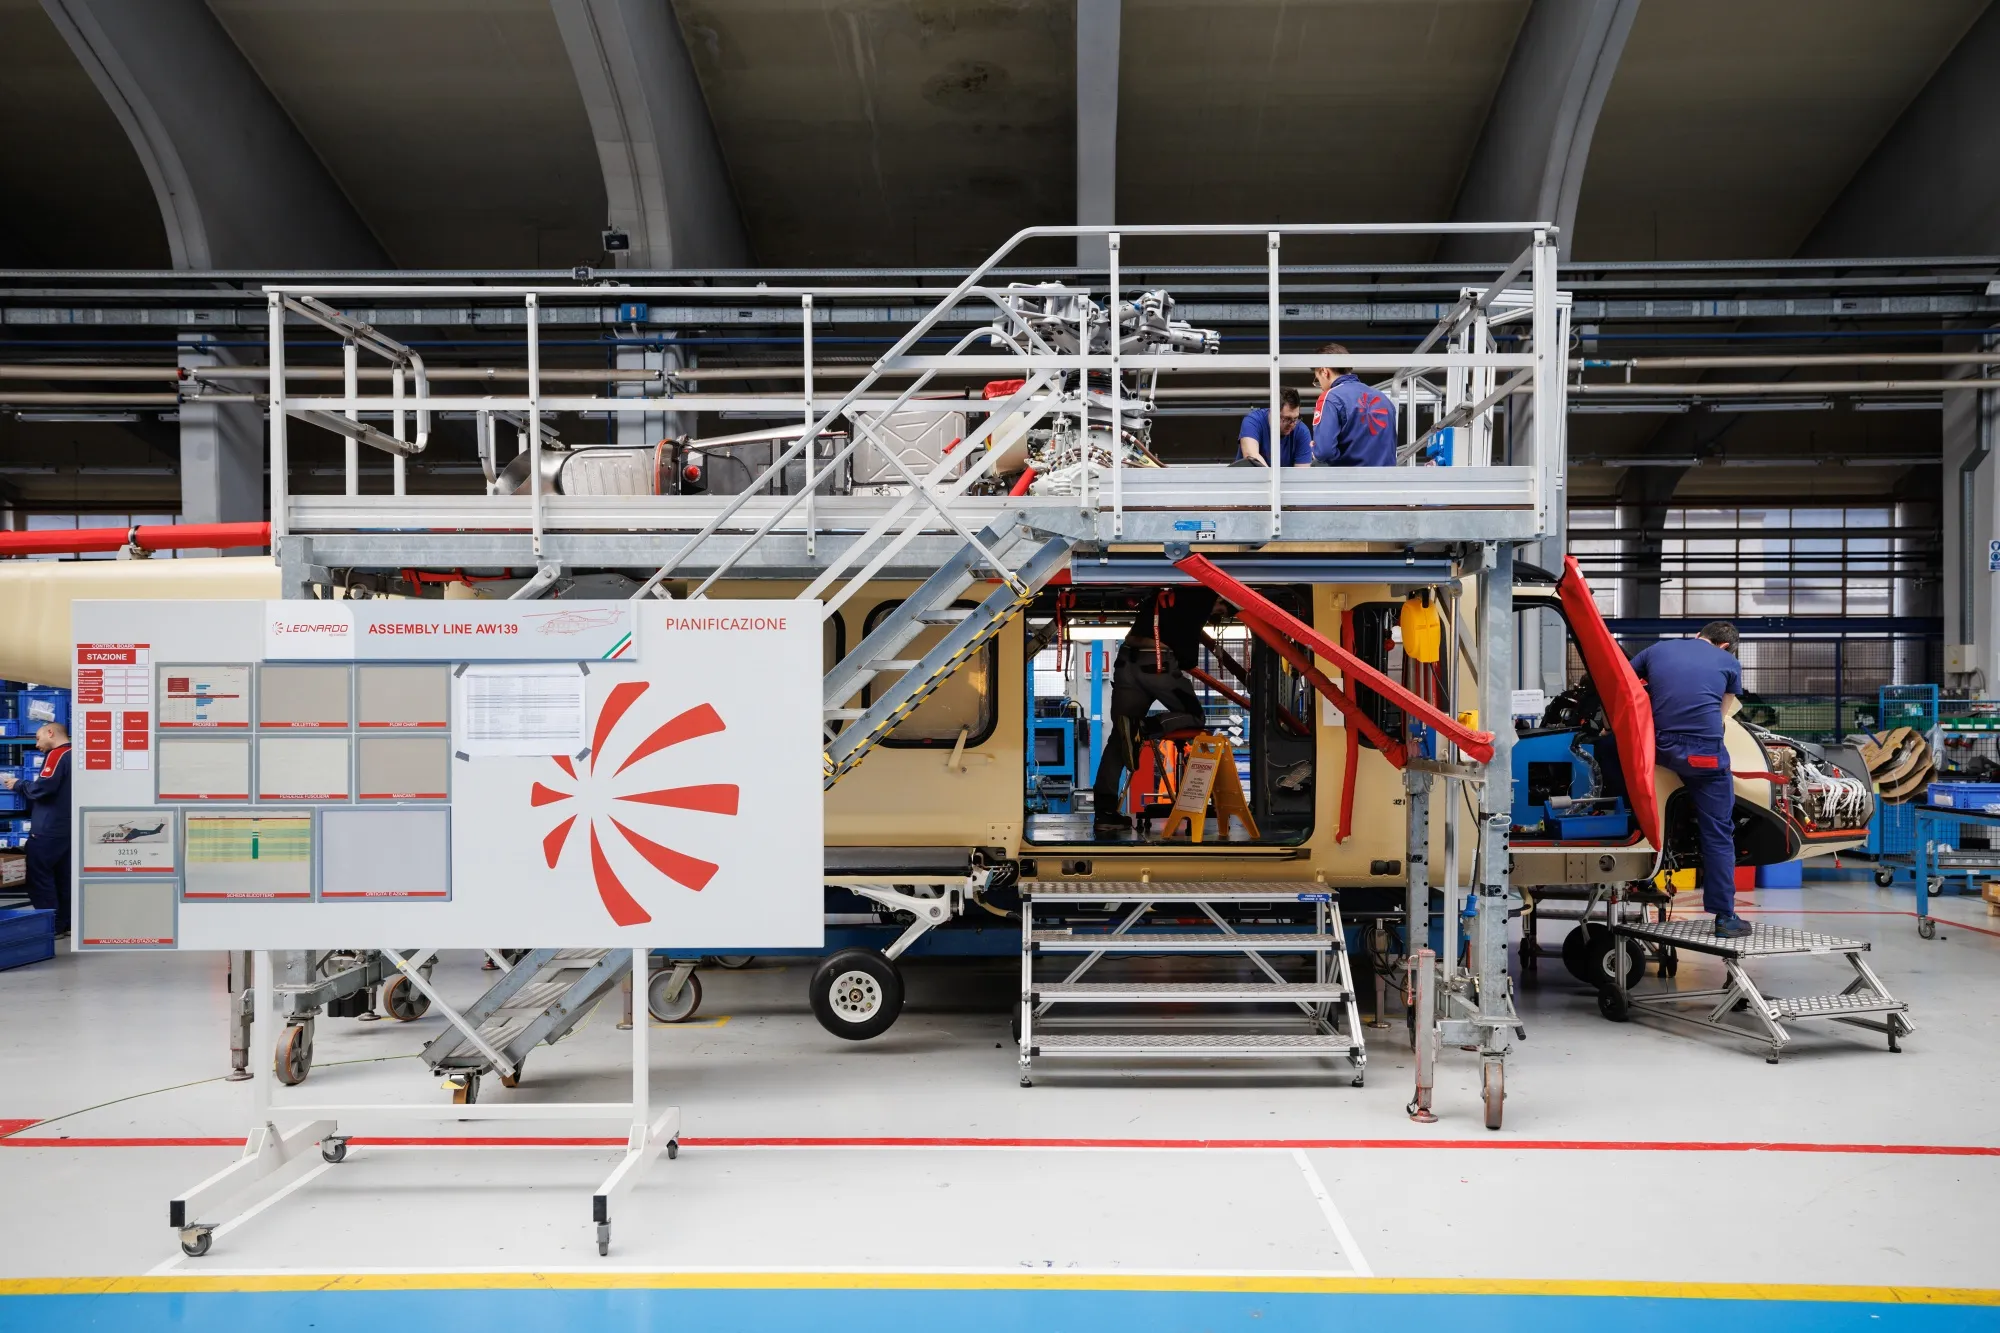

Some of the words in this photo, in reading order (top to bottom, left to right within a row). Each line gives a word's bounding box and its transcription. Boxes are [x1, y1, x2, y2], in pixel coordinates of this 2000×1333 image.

[286, 624, 349, 633] LEONARDO
[368, 623, 440, 635] ASSEMBLY
[443, 623, 472, 635] LINE
[475, 623, 518, 635] AW139
[666, 618, 787, 631] PIANIFICAZIONE
[86, 653, 128, 661] STAZIONE
[117, 848, 138, 856] 32119
